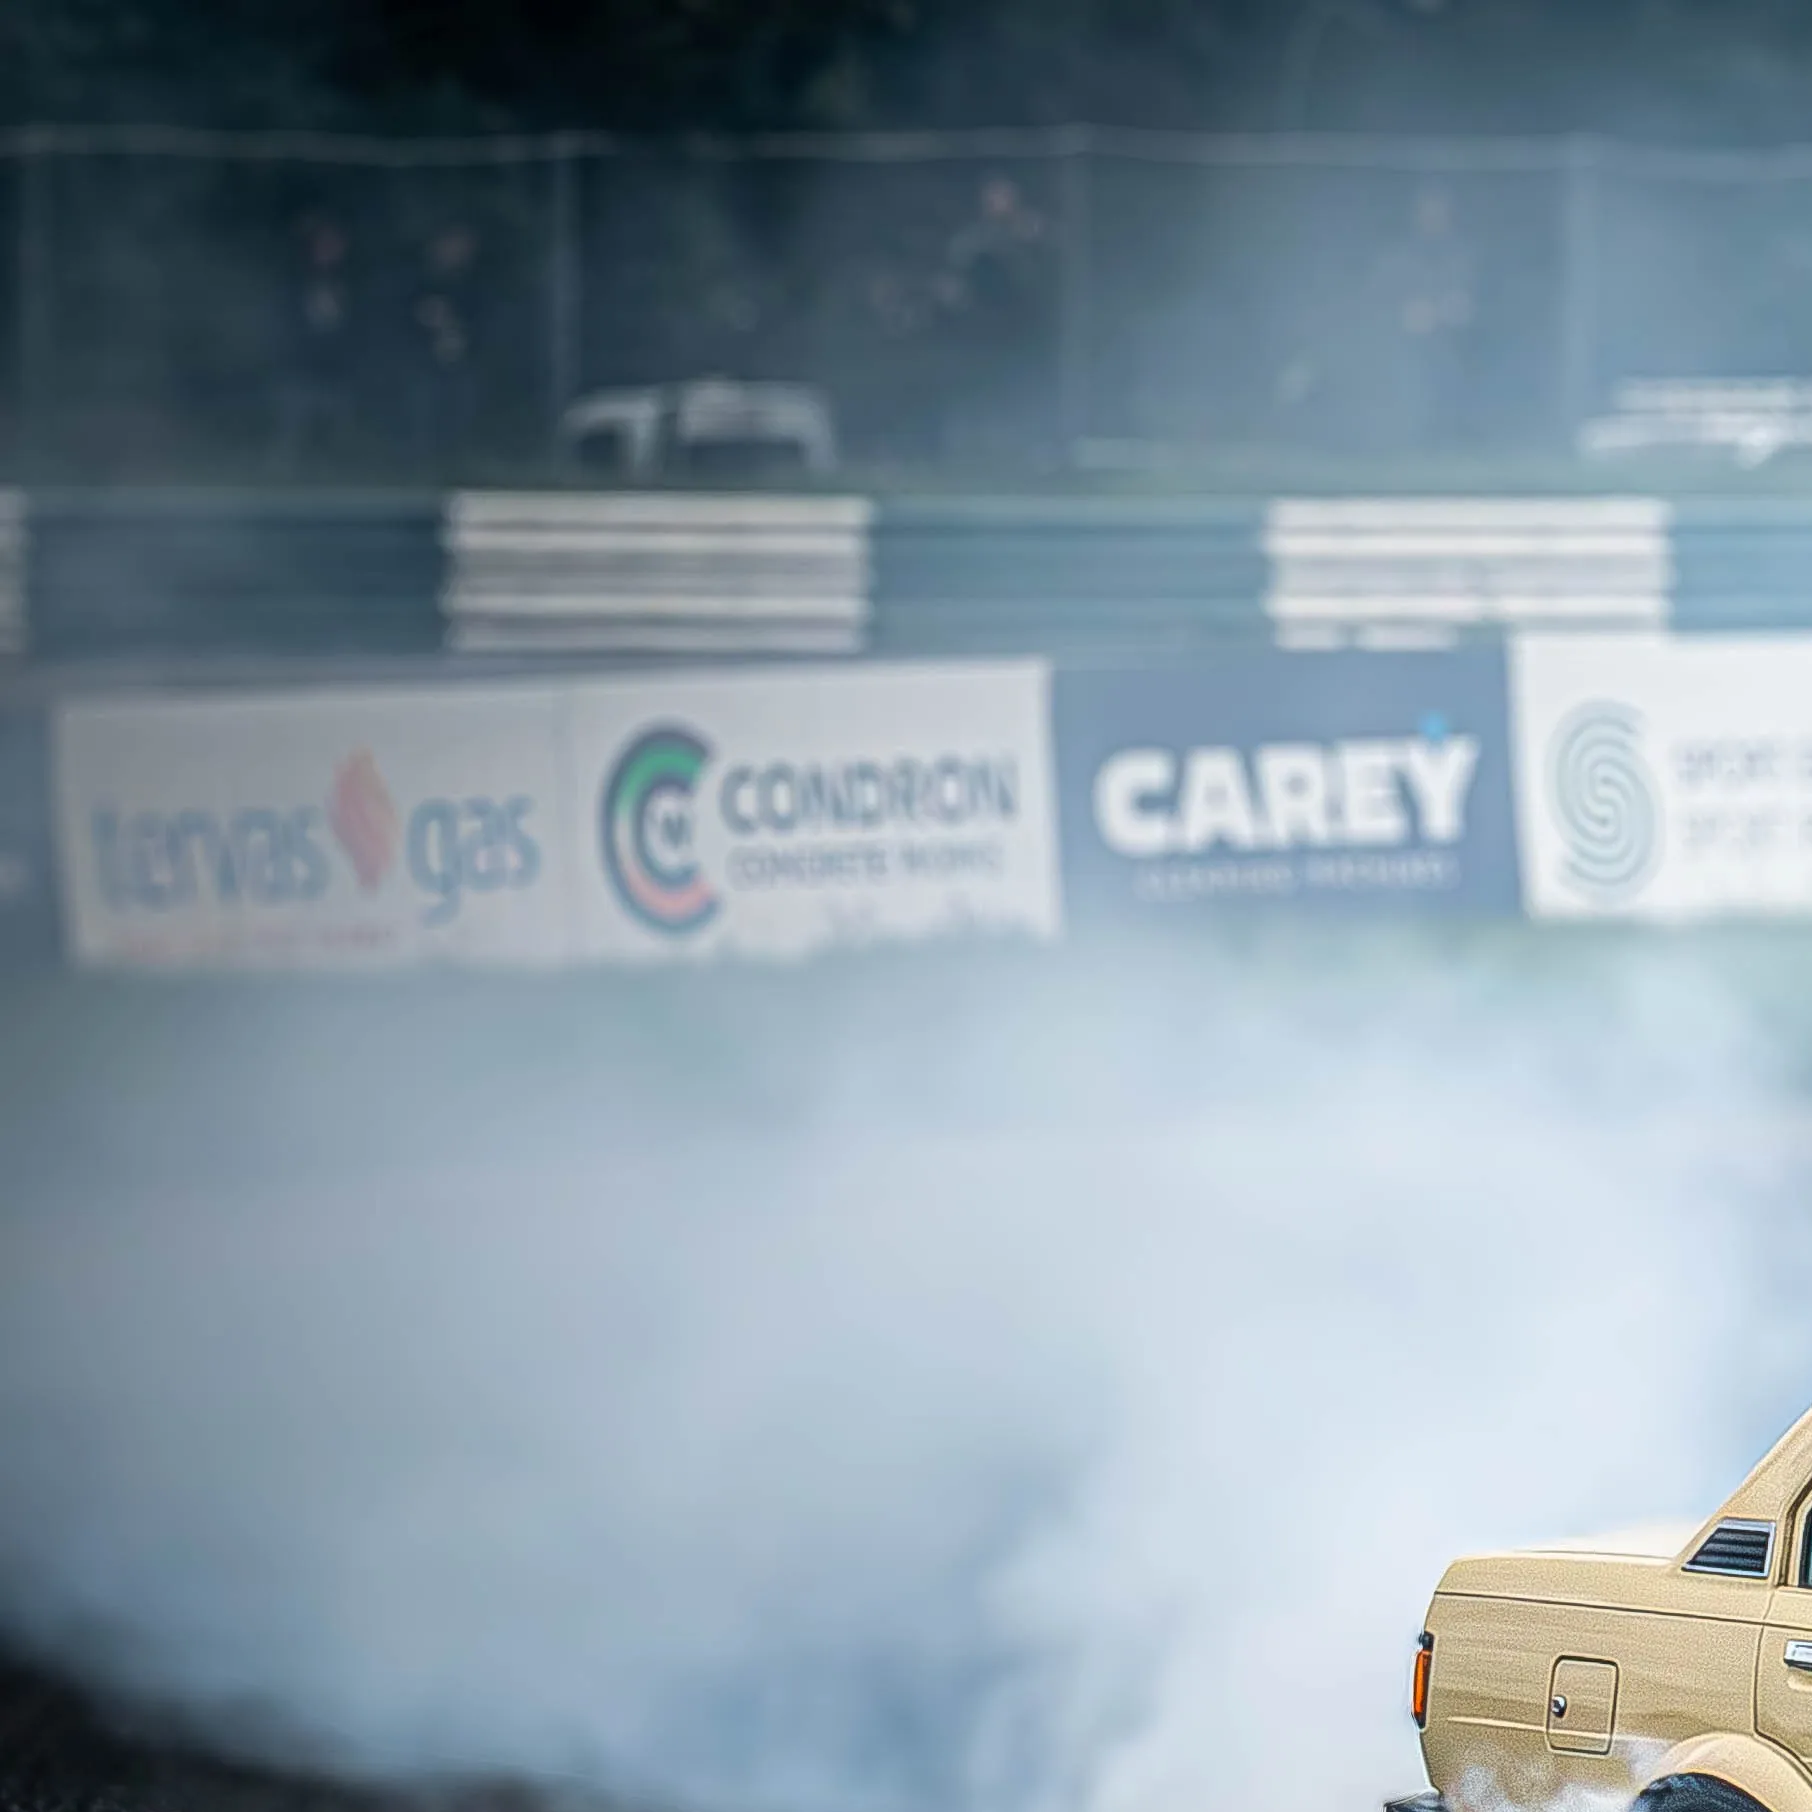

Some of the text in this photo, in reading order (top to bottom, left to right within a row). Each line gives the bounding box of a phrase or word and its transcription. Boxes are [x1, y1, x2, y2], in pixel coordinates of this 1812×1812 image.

[718, 756, 1021, 835] CONDRON
[1096, 733, 1478, 855] CAREY
[408, 797, 540, 922] gas
